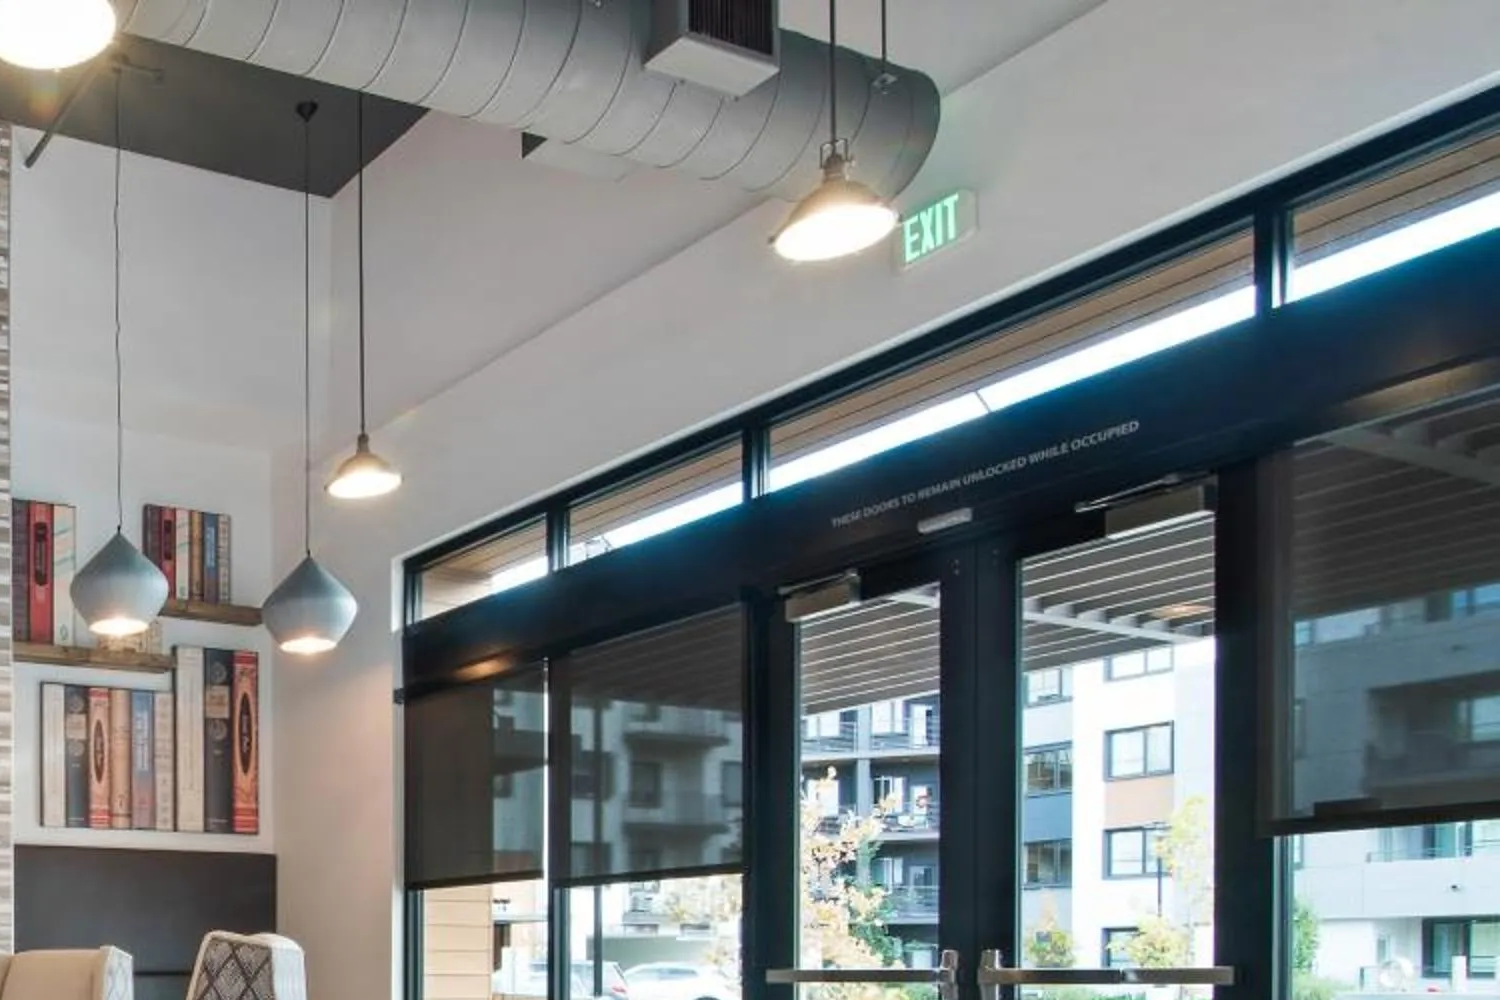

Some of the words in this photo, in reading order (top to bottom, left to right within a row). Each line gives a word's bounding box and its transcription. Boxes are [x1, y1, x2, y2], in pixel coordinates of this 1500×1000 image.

[903, 192, 959, 263] EXIT
[832, 509, 861, 528] THESE
[862, 498, 900, 517] DOORS
[901, 492, 916, 505] TO
[918, 479, 960, 499] REMAIN
[962, 456, 1027, 485] UNLOCKED
[1029, 443, 1069, 465] WHILE
[1071, 420, 1140, 450] OCCUPIED
